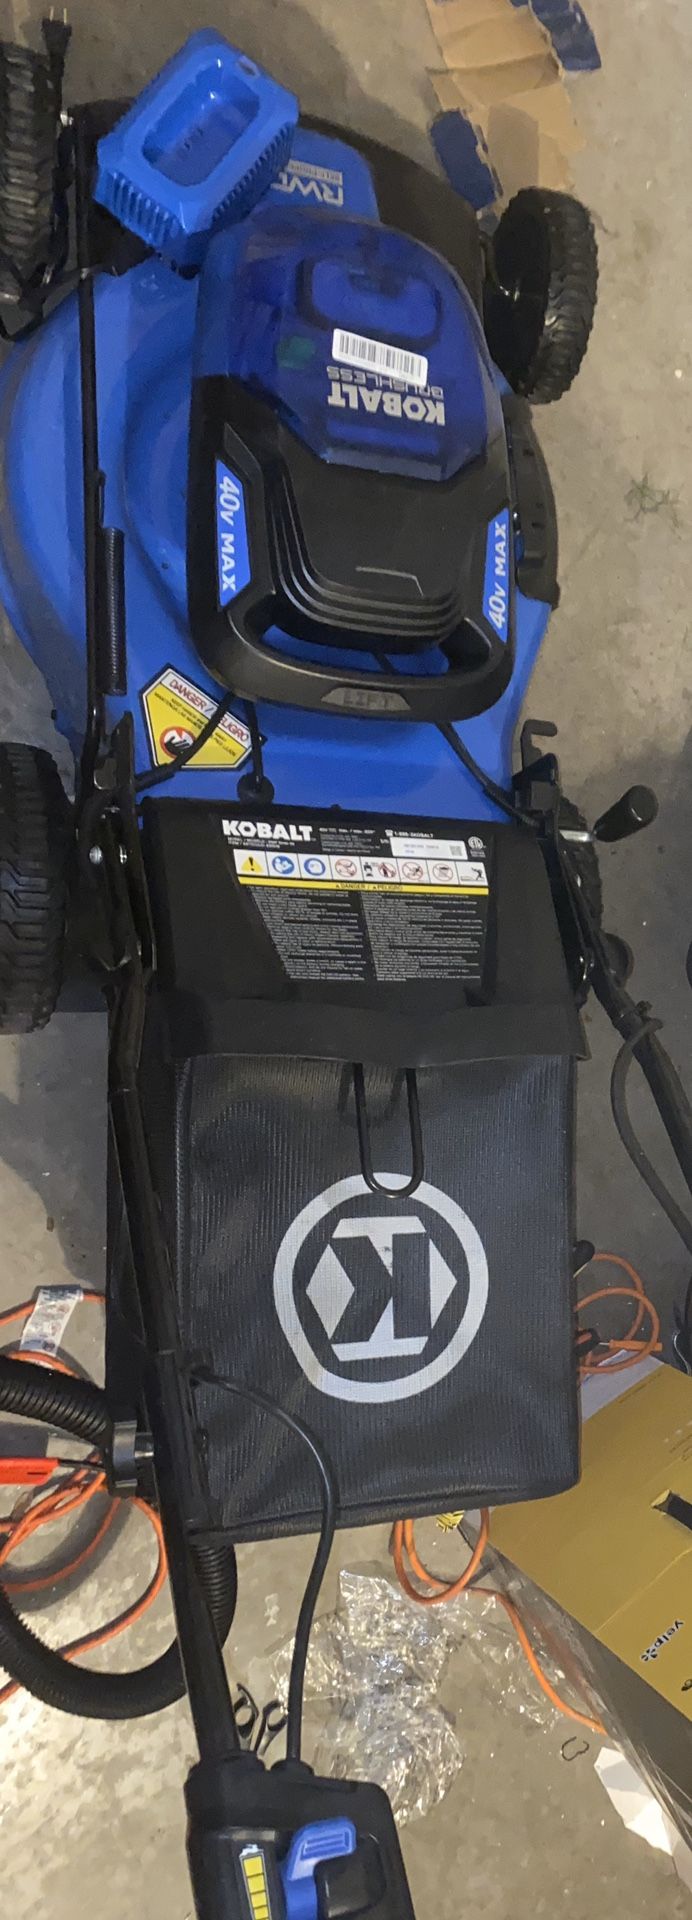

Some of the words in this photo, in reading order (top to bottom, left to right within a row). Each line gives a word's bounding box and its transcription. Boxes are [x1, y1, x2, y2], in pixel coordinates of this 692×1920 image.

[326, 365, 444, 400] BRUSHLESS
[327, 381, 446, 426] KOBALT
[220, 532, 237, 592] MAX
[494, 520, 508, 578] MAX
[169, 679, 207, 710] DANGER
[219, 716, 250, 742] ELIGRO
[343, 689, 394, 708] LIFT
[222, 819, 313, 842] KOBALT
